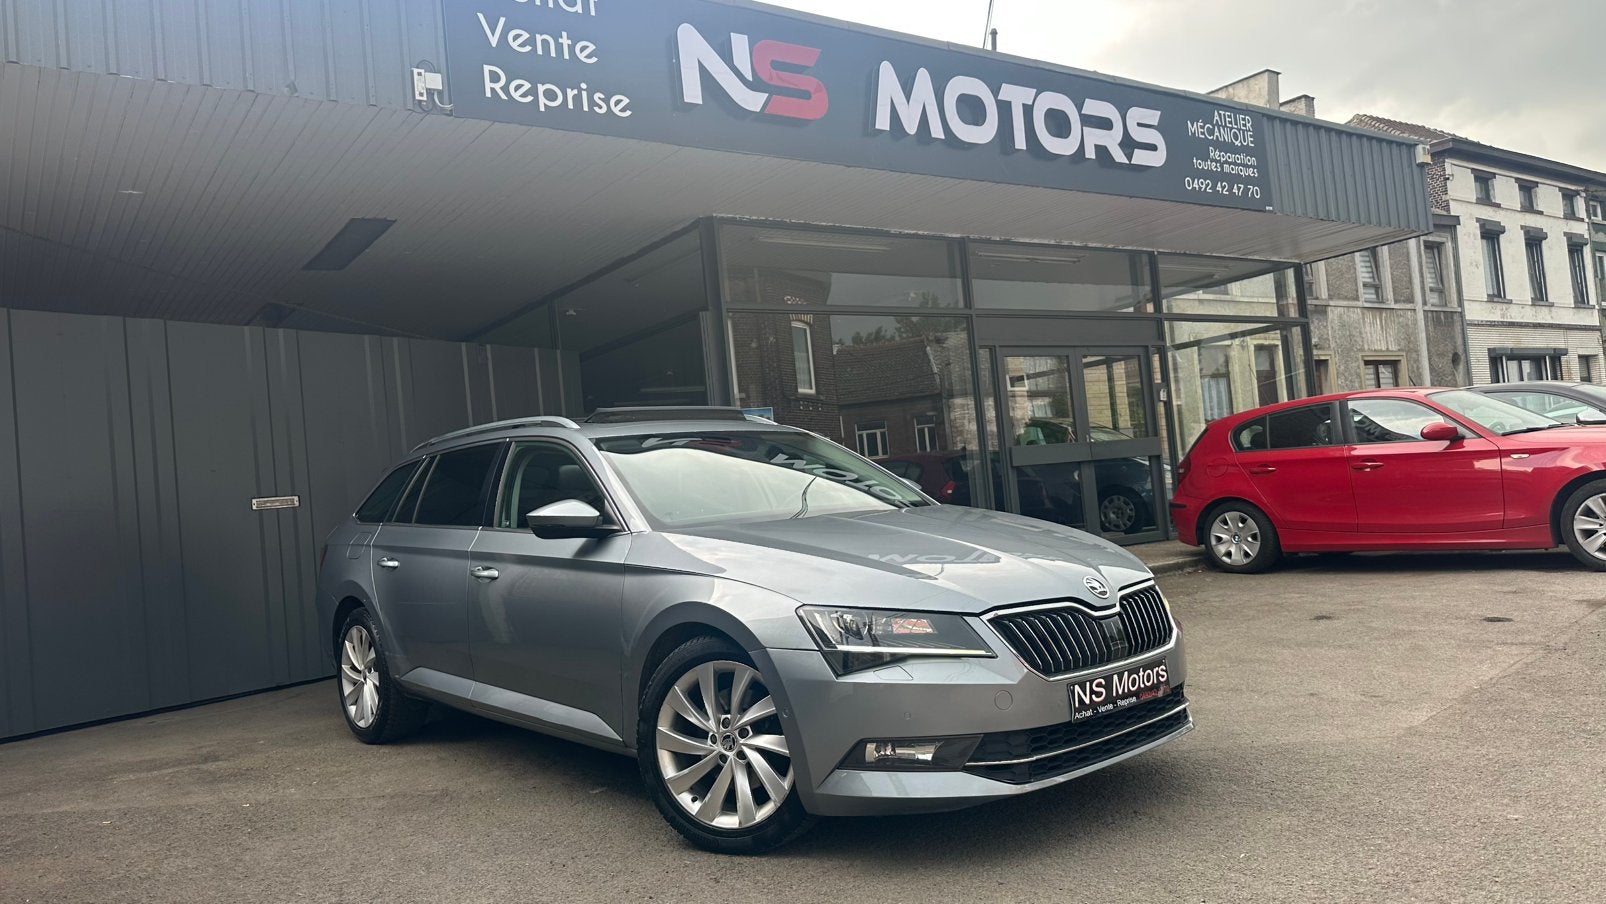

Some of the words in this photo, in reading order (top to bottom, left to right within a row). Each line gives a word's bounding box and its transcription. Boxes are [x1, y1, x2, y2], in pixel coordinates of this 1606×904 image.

[476, 12, 599, 64] Vente
[482, 64, 632, 118] Reprise
[676, 22, 829, 120] NS
[874, 60, 1167, 168] MOTORS
[1187, 119, 1255, 147] MÉCANIQUE
[1213, 110, 1253, 131] ATELIER
[1193, 156, 1221, 172] toutes
[1223, 164, 1258, 178] marques
[1209, 147, 1257, 166] Réparation
[1185, 177, 1213, 193] 0492
[1216, 181, 1229, 195] 42
[1232, 184, 1244, 196] 47
[1247, 185, 1261, 199] 70
[1074, 678, 1106, 708] NS
[1112, 664, 1168, 697] Motors
[1074, 709, 1093, 720] Achat
[1097, 703, 1114, 713] Vente
